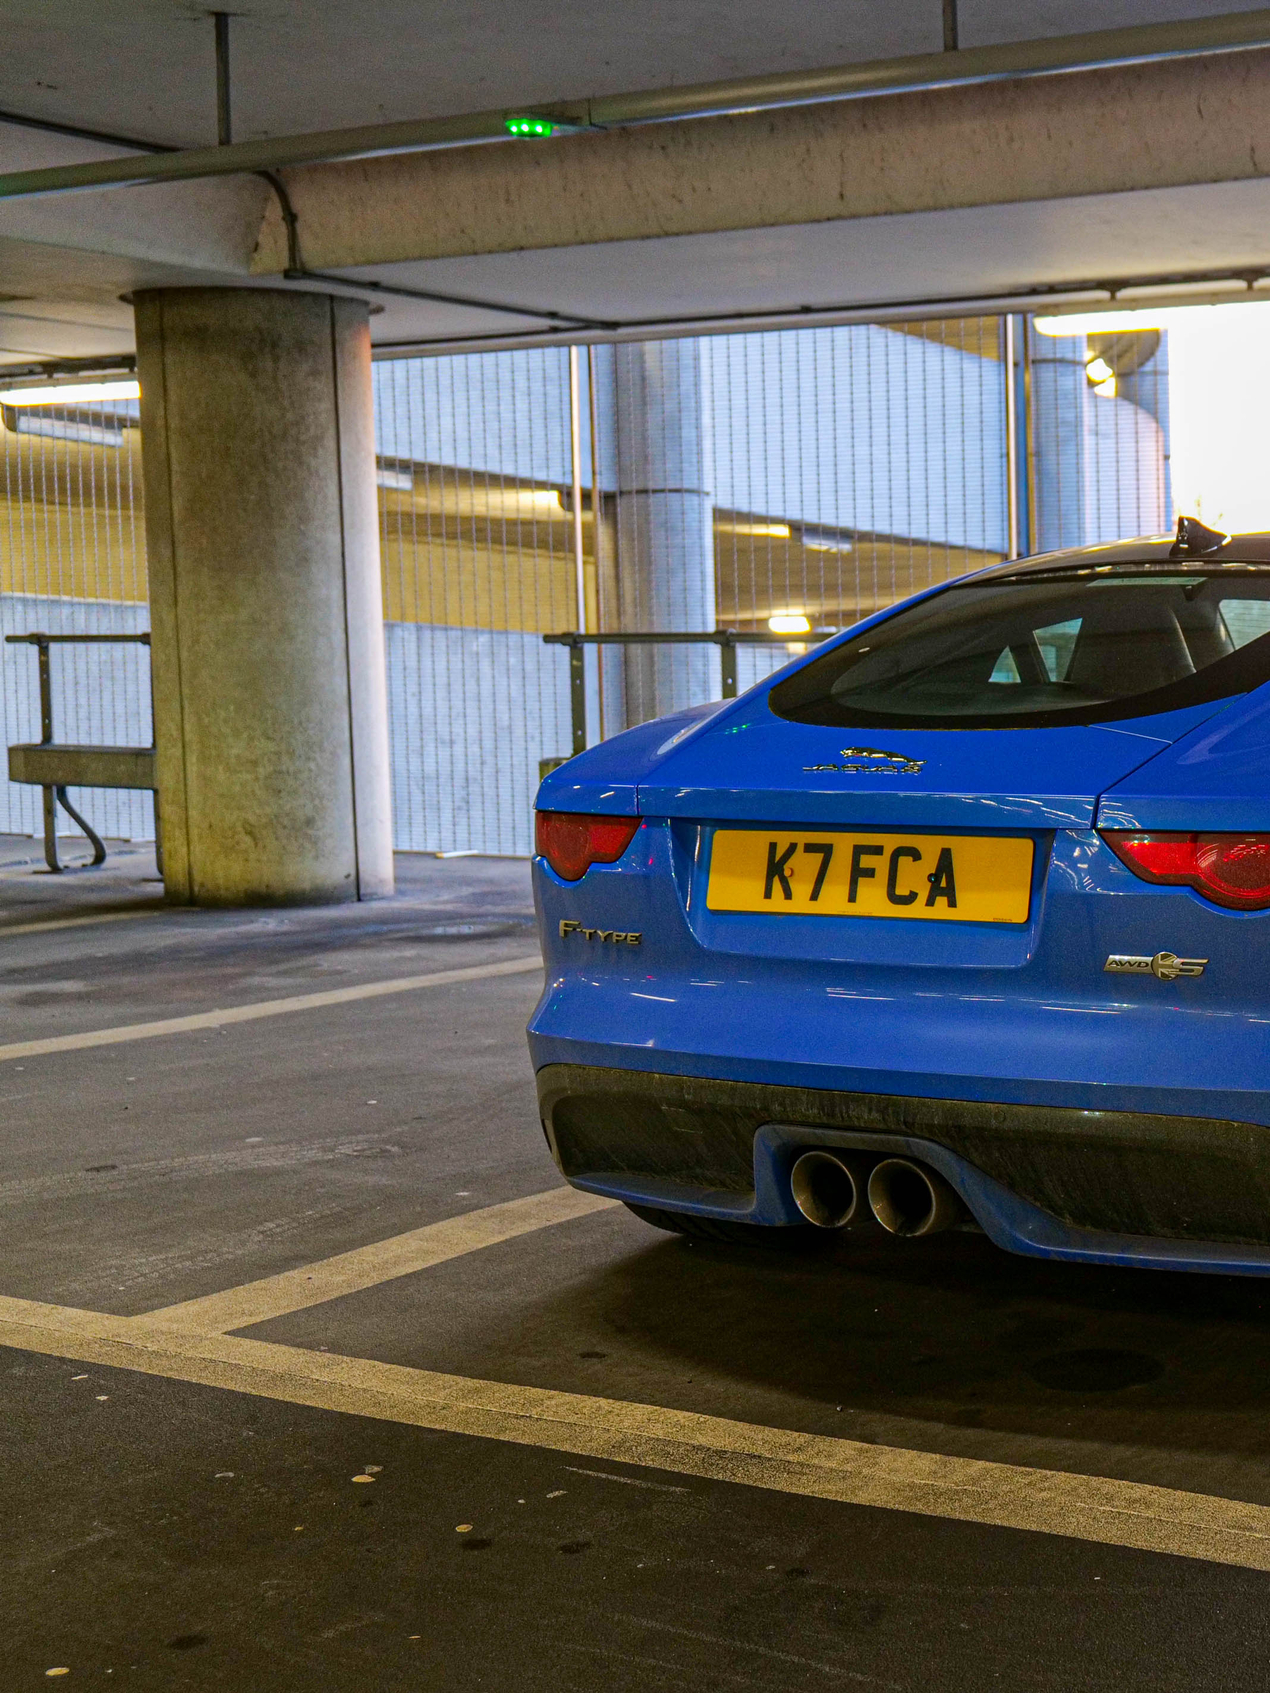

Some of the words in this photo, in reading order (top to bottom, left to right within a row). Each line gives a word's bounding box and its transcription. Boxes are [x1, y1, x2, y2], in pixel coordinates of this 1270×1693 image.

[763, 841, 834, 901] K7
[847, 844, 957, 908] FCA
[1108, 960, 1150, 968] AWD
